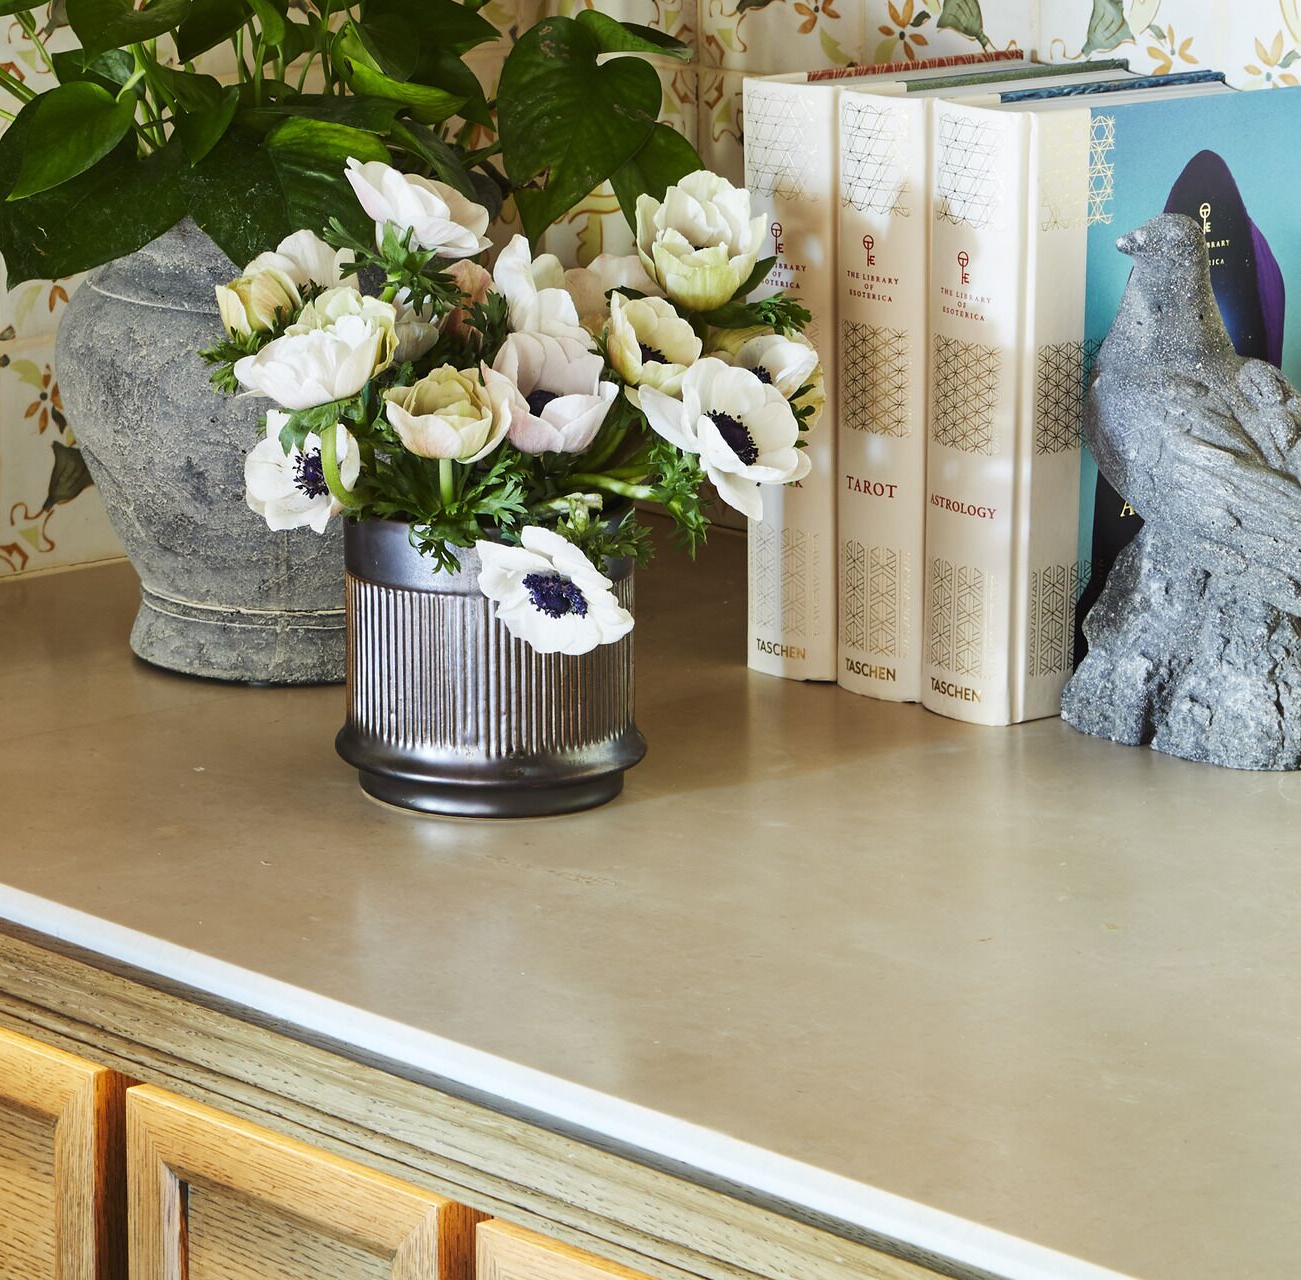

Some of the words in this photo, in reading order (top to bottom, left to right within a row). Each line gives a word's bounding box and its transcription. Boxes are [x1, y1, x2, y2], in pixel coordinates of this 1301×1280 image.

[1207, 239, 1230, 249] BRARY
[762, 278, 801, 289] OTERICA
[847, 270, 860, 279] THE
[862, 273, 899, 285] LIBRARY
[864, 283, 874, 291] OF
[849, 289, 893, 303] ESOTERICA
[940, 287, 953, 297] THE
[956, 291, 992, 304] LIBRARY
[942, 305, 985, 321] ESOTERICA
[957, 301, 966, 309] OF
[846, 475, 897, 499] TAROT
[930, 493, 997, 520] ASTROLOGY
[756, 638, 806, 660] TASCHEN
[845, 657, 897, 682] TASCHEN
[930, 677, 981, 703] TASCHEN
